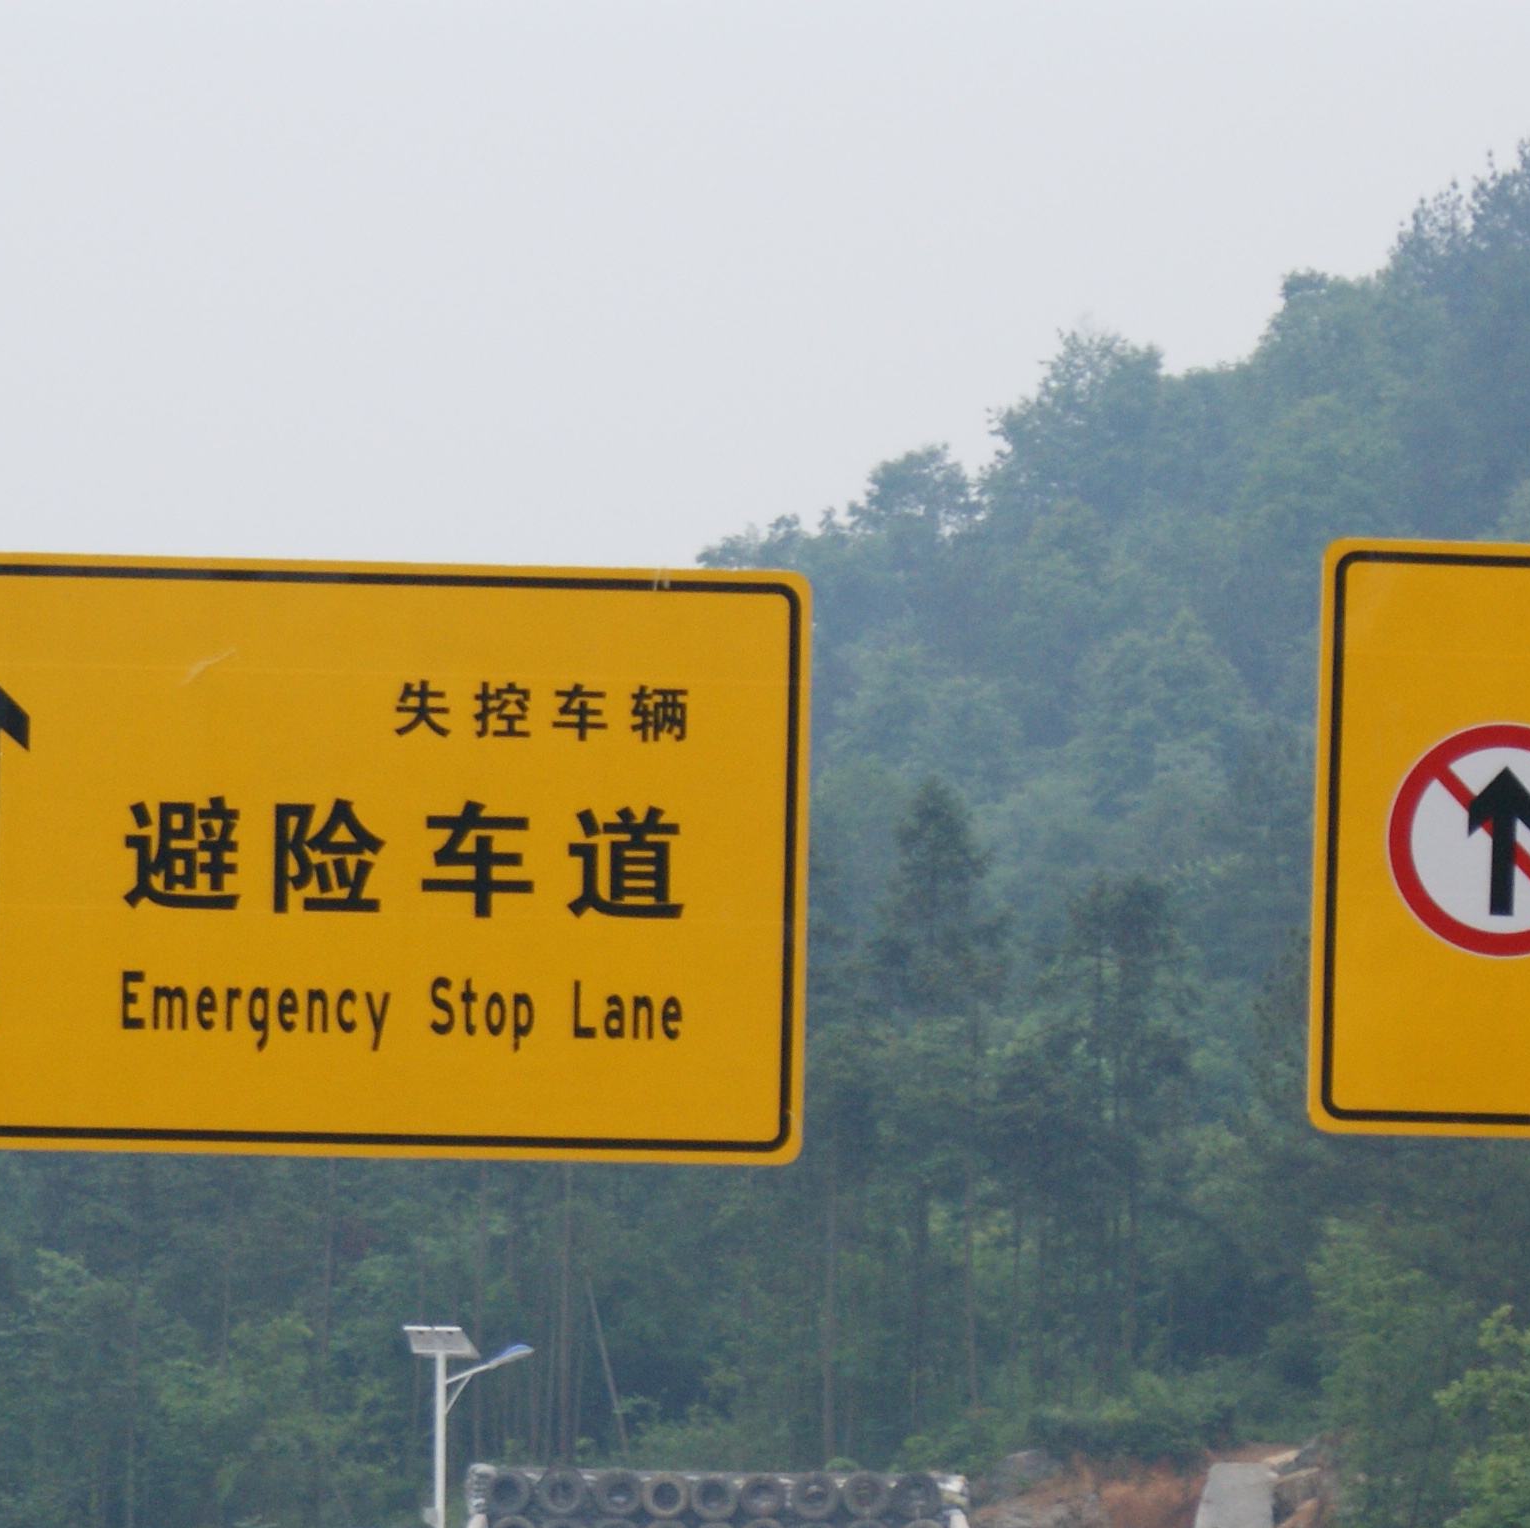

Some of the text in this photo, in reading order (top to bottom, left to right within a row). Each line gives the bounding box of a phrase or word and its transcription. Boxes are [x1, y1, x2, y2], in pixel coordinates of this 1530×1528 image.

[394, 679, 688, 743] 失控车辆
[123, 795, 685, 919] 避险车道
[121, 970, 683, 1053] Emergency Stop Lane
